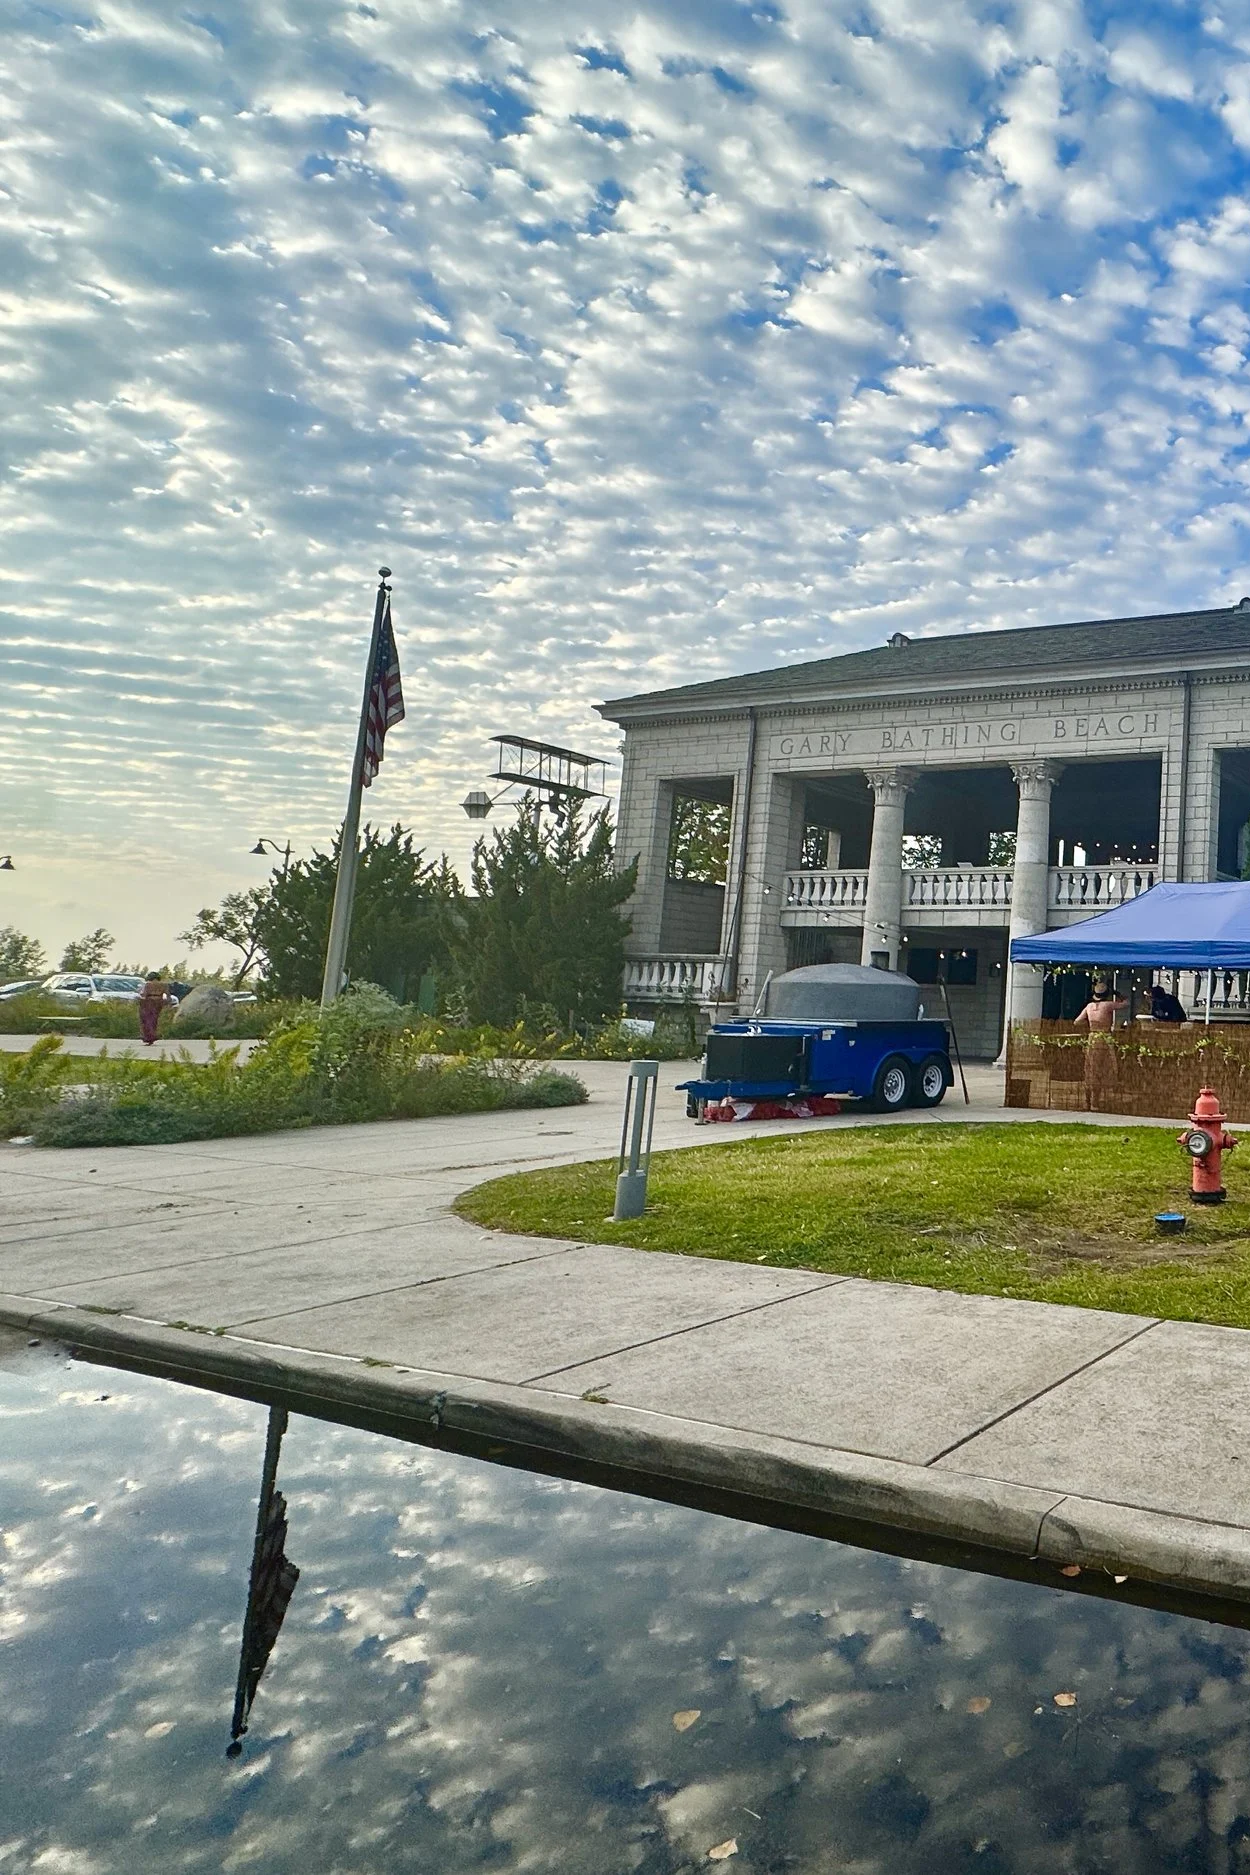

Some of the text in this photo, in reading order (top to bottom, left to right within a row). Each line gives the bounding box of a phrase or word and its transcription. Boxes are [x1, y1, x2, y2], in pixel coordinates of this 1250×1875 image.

[780, 714, 1159, 755] GARY BATHING BEACH
